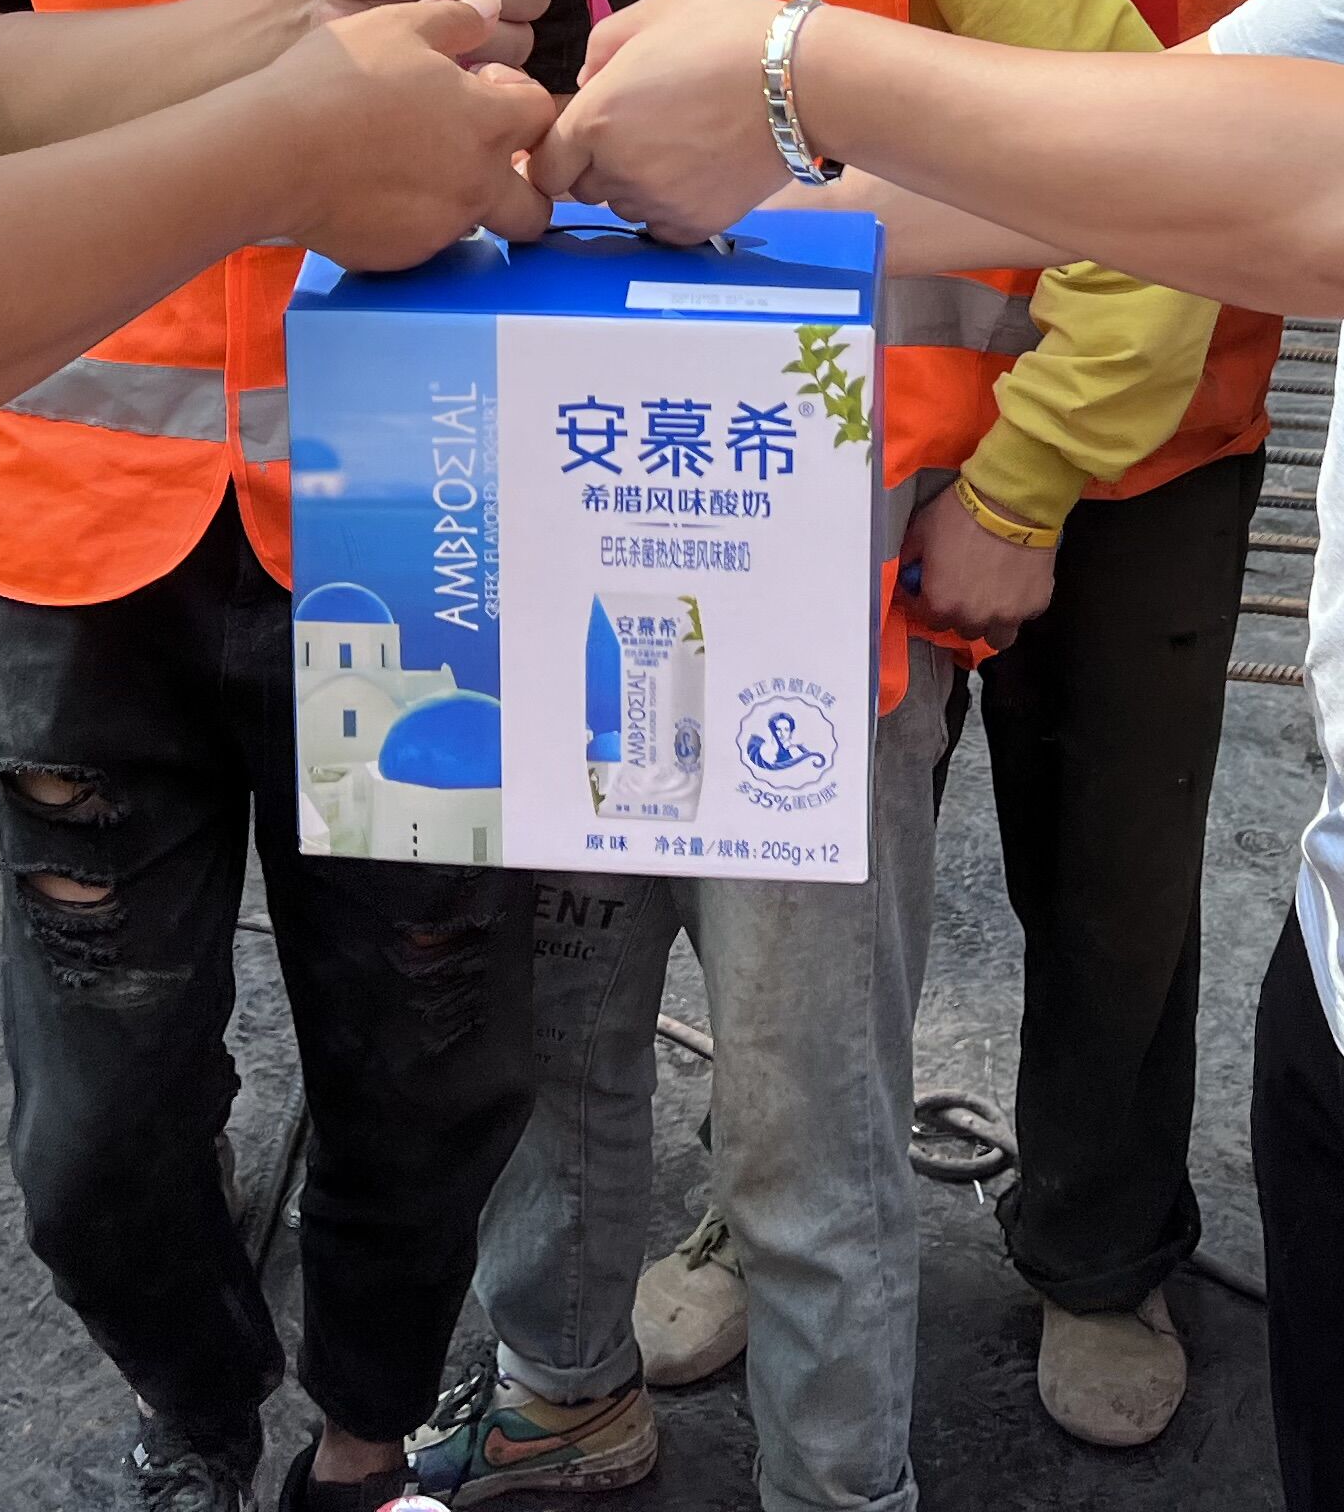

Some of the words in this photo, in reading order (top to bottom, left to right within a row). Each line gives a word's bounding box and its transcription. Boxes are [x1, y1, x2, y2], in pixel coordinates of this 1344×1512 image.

[556, 394, 797, 481] 安慕希
[582, 483, 771, 519] 希腊风味酸奶
[600, 536, 751, 573] 巴氏杀菌热处理风味酸奶
[586, 834, 628, 851] 原味
